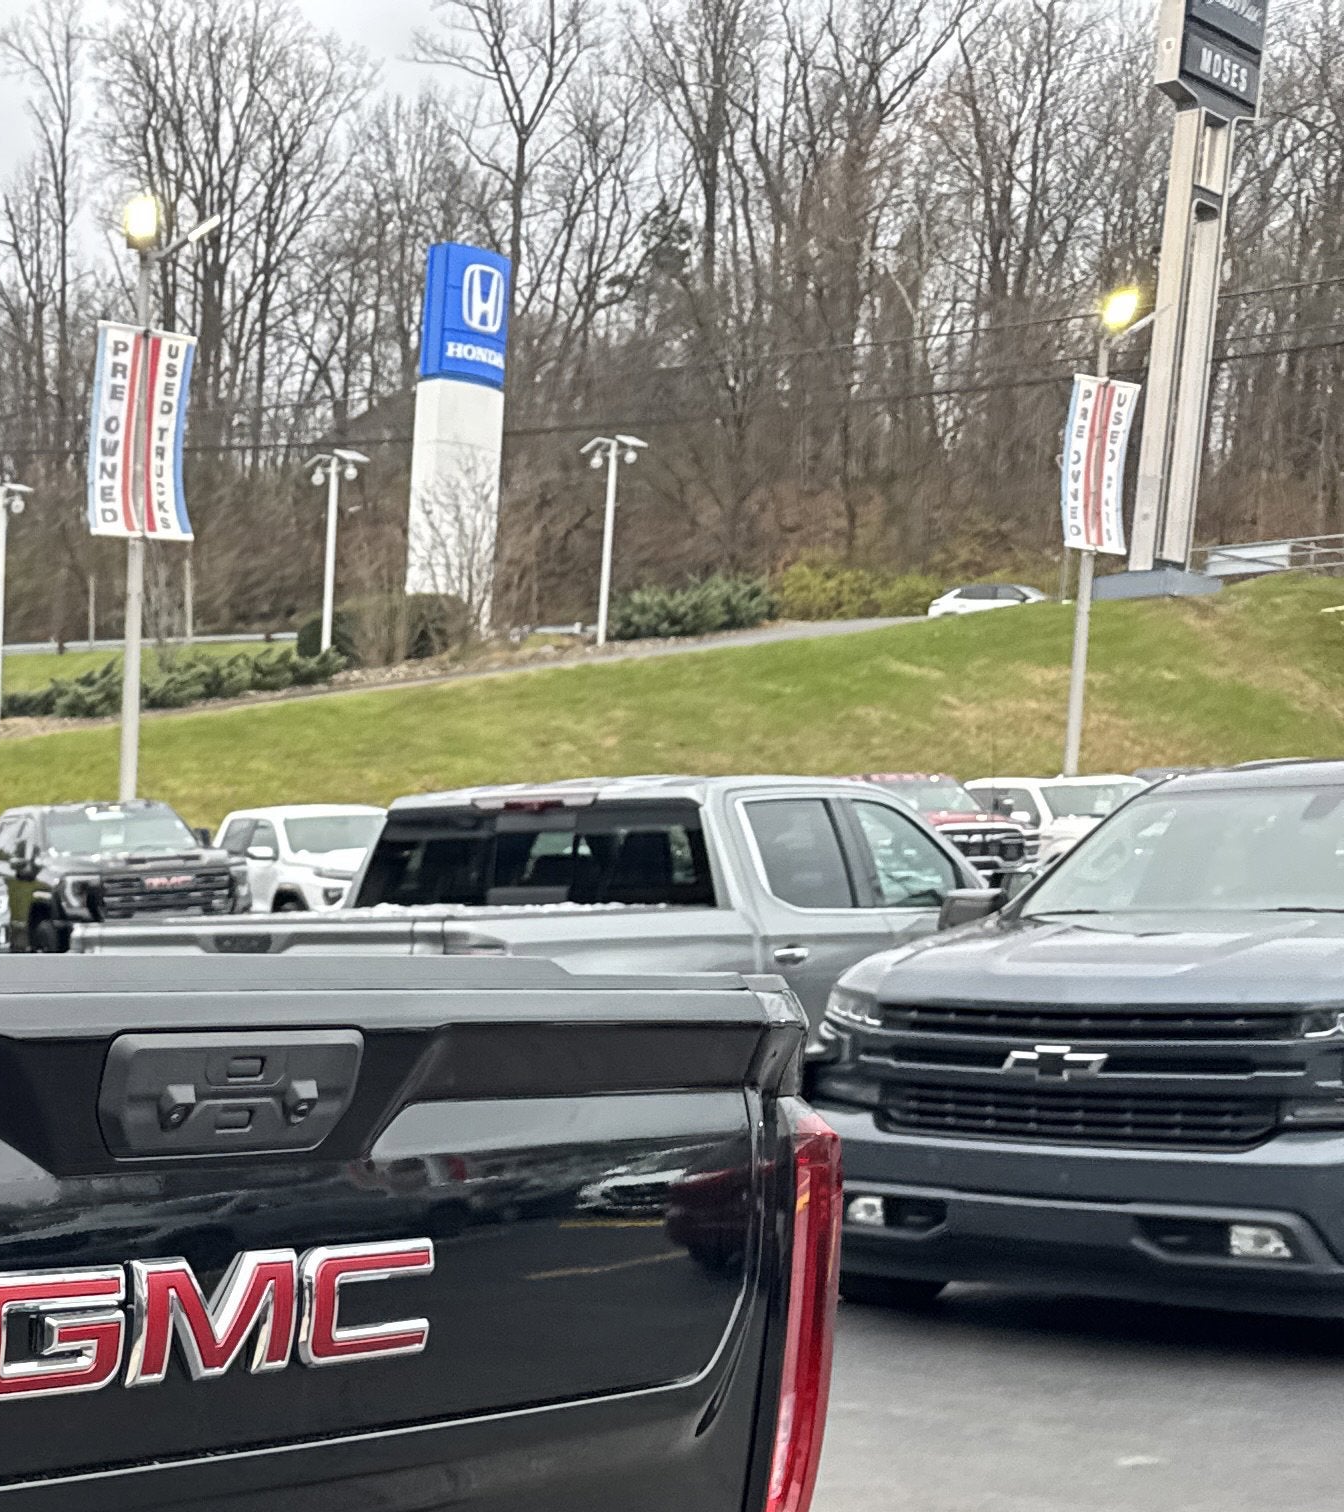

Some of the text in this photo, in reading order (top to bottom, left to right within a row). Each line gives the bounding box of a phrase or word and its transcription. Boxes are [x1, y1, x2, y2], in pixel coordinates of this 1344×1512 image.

[1200, 47, 1248, 93] MOSES
[446, 341, 504, 369] HONDA
[98, 339, 129, 524] PRE OWNED
[155, 344, 180, 530] USED TRUCKS
